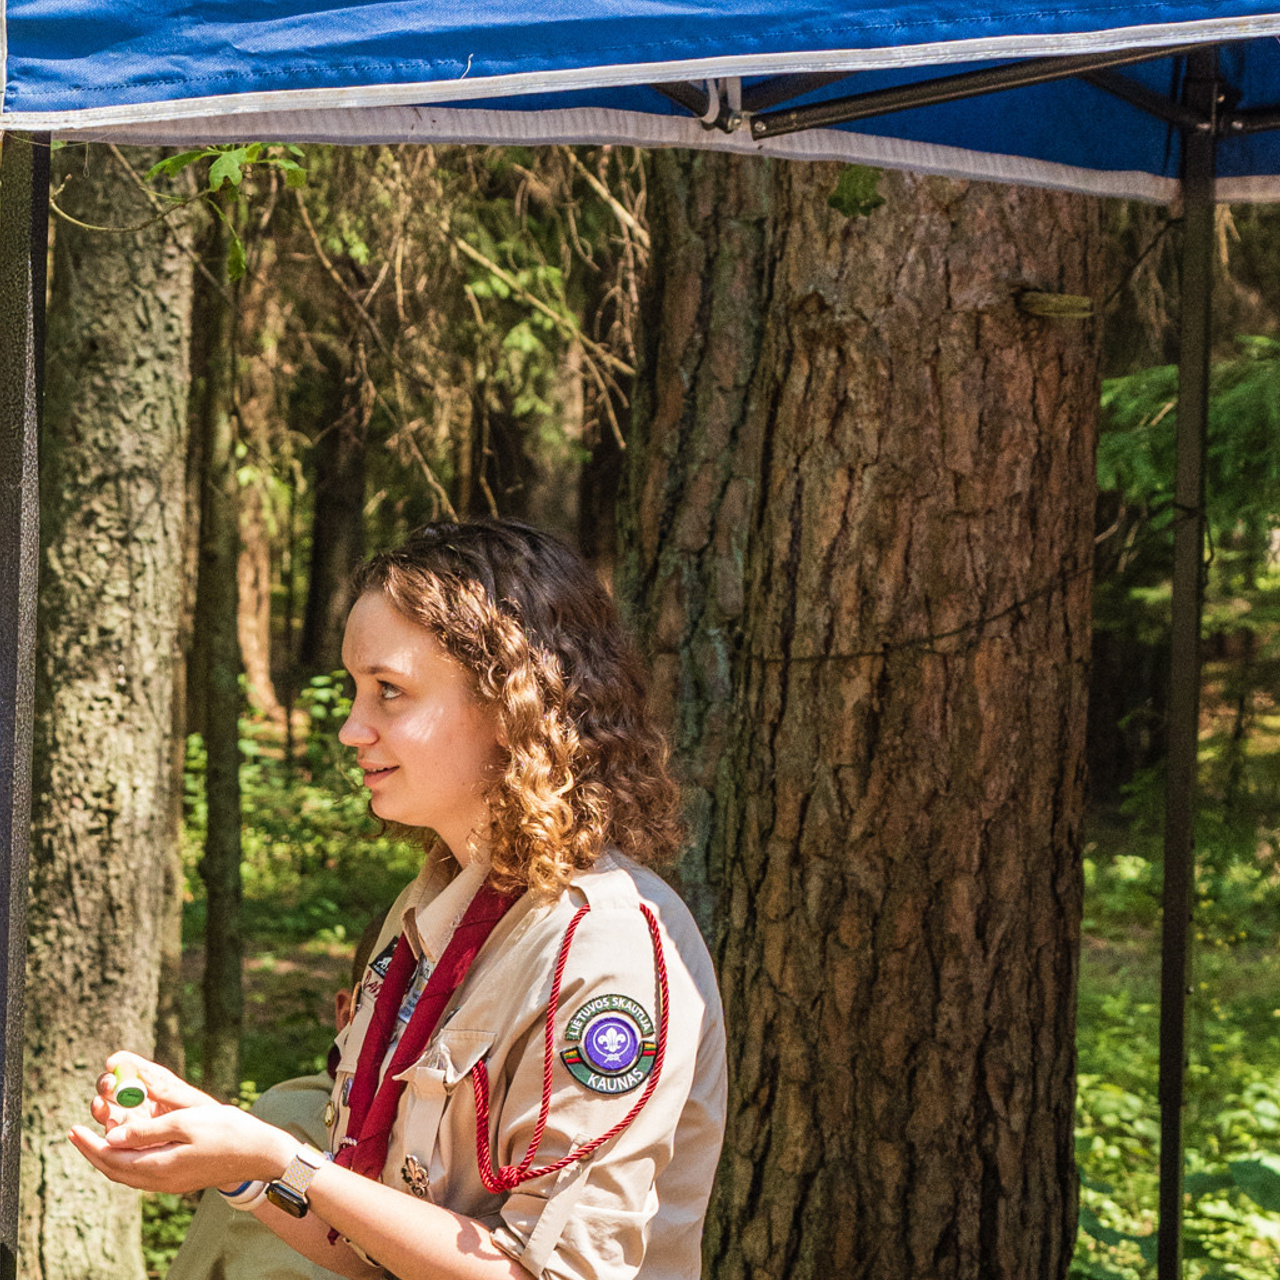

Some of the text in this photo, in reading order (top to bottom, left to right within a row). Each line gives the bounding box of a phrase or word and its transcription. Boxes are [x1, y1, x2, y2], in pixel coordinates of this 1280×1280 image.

[570, 997, 652, 1036] LIETUVOS SKAUTIJA
[588, 1068, 643, 1090] KAUNAS
